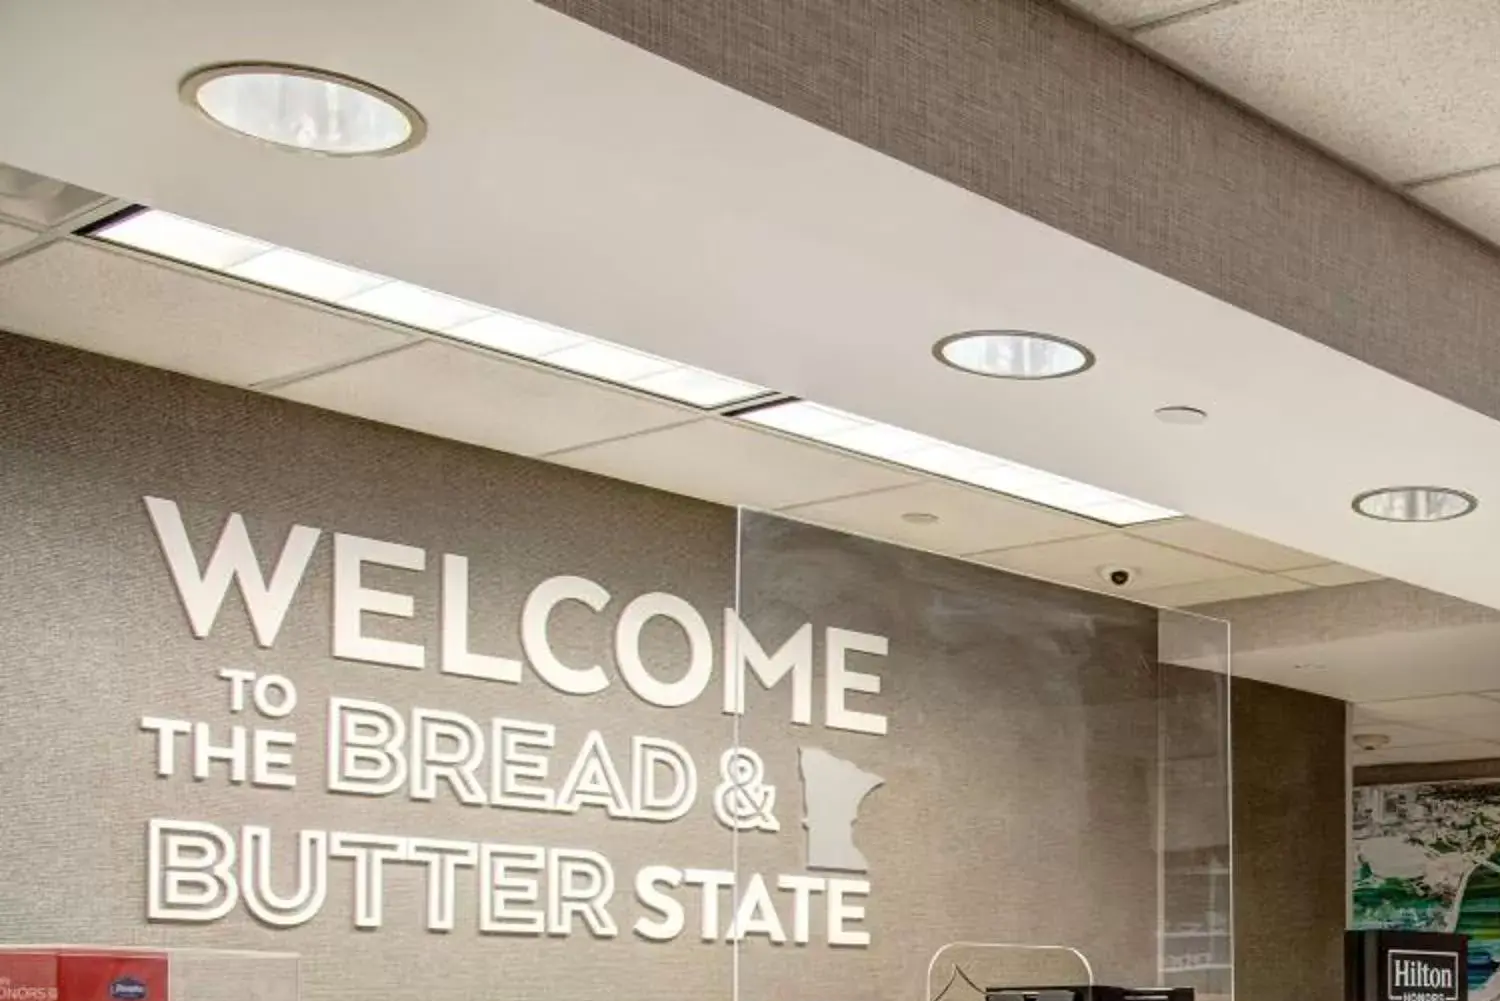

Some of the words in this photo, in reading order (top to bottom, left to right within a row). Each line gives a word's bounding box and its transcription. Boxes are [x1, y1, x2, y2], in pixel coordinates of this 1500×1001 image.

[143, 495, 888, 736] WELCOME
[218, 666, 298, 718] TO
[140, 715, 298, 787] THE
[328, 695, 697, 822] BREAD
[713, 745, 781, 834] &
[145, 817, 618, 938] BUTTER
[633, 862, 873, 946] STATE
[1394, 959, 1452, 989] Hilton
